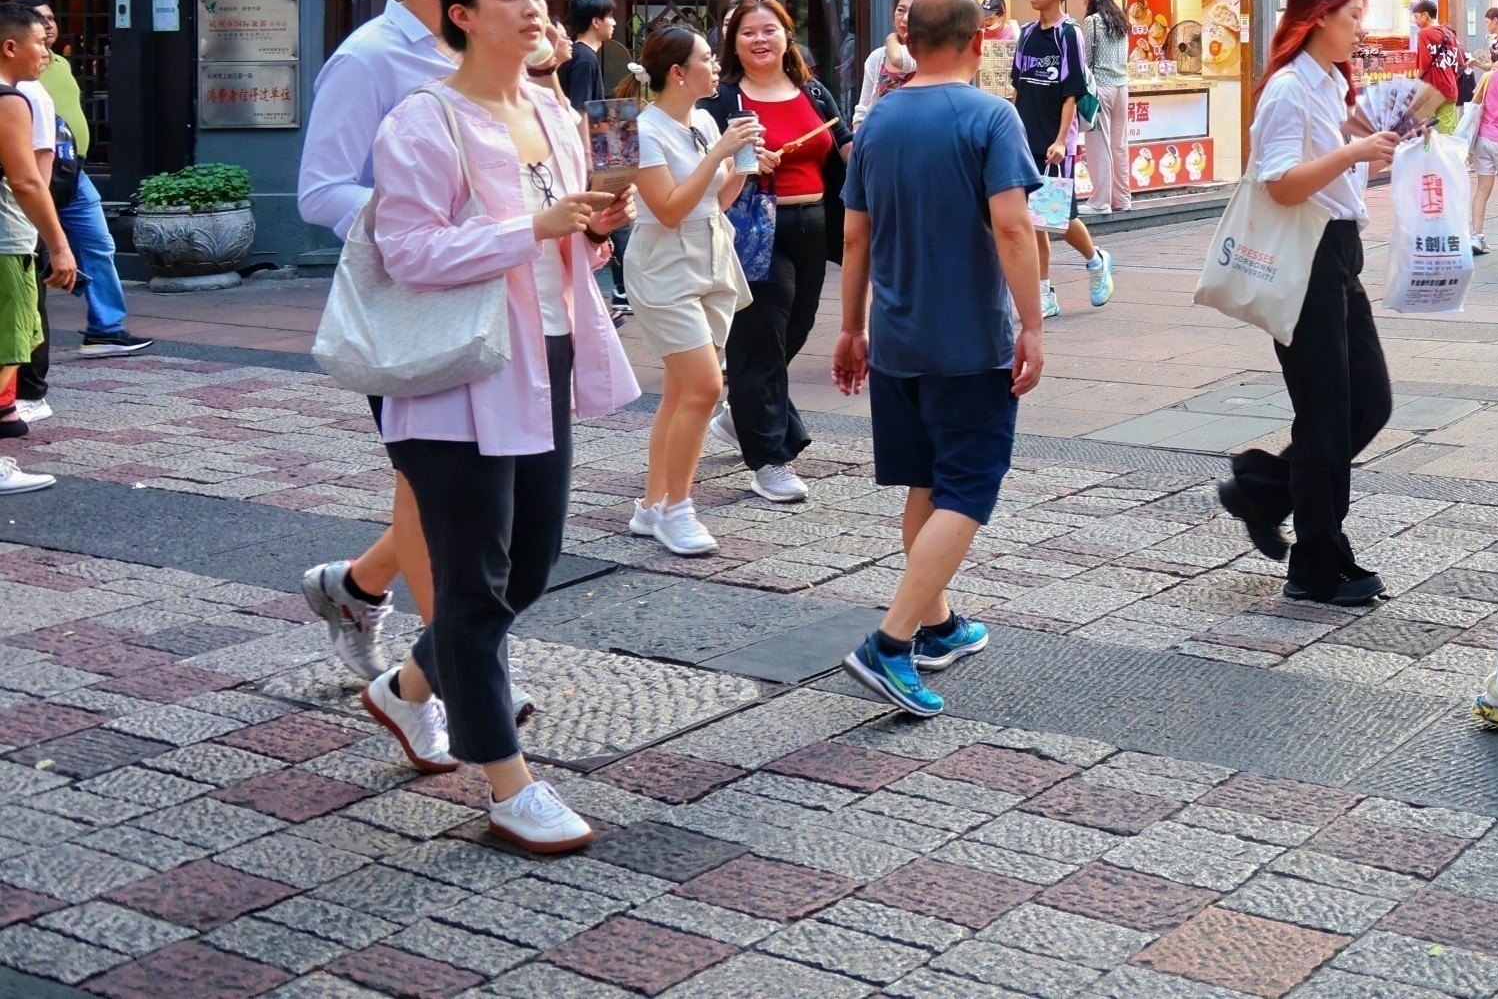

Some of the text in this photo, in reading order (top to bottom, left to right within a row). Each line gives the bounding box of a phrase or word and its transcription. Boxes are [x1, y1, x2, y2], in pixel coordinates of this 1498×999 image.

[207, 86, 291, 103] 消费者信得过单位
[1234, 253, 1278, 275] SORBONNE
[1238, 244, 1275, 265] PRESSES
